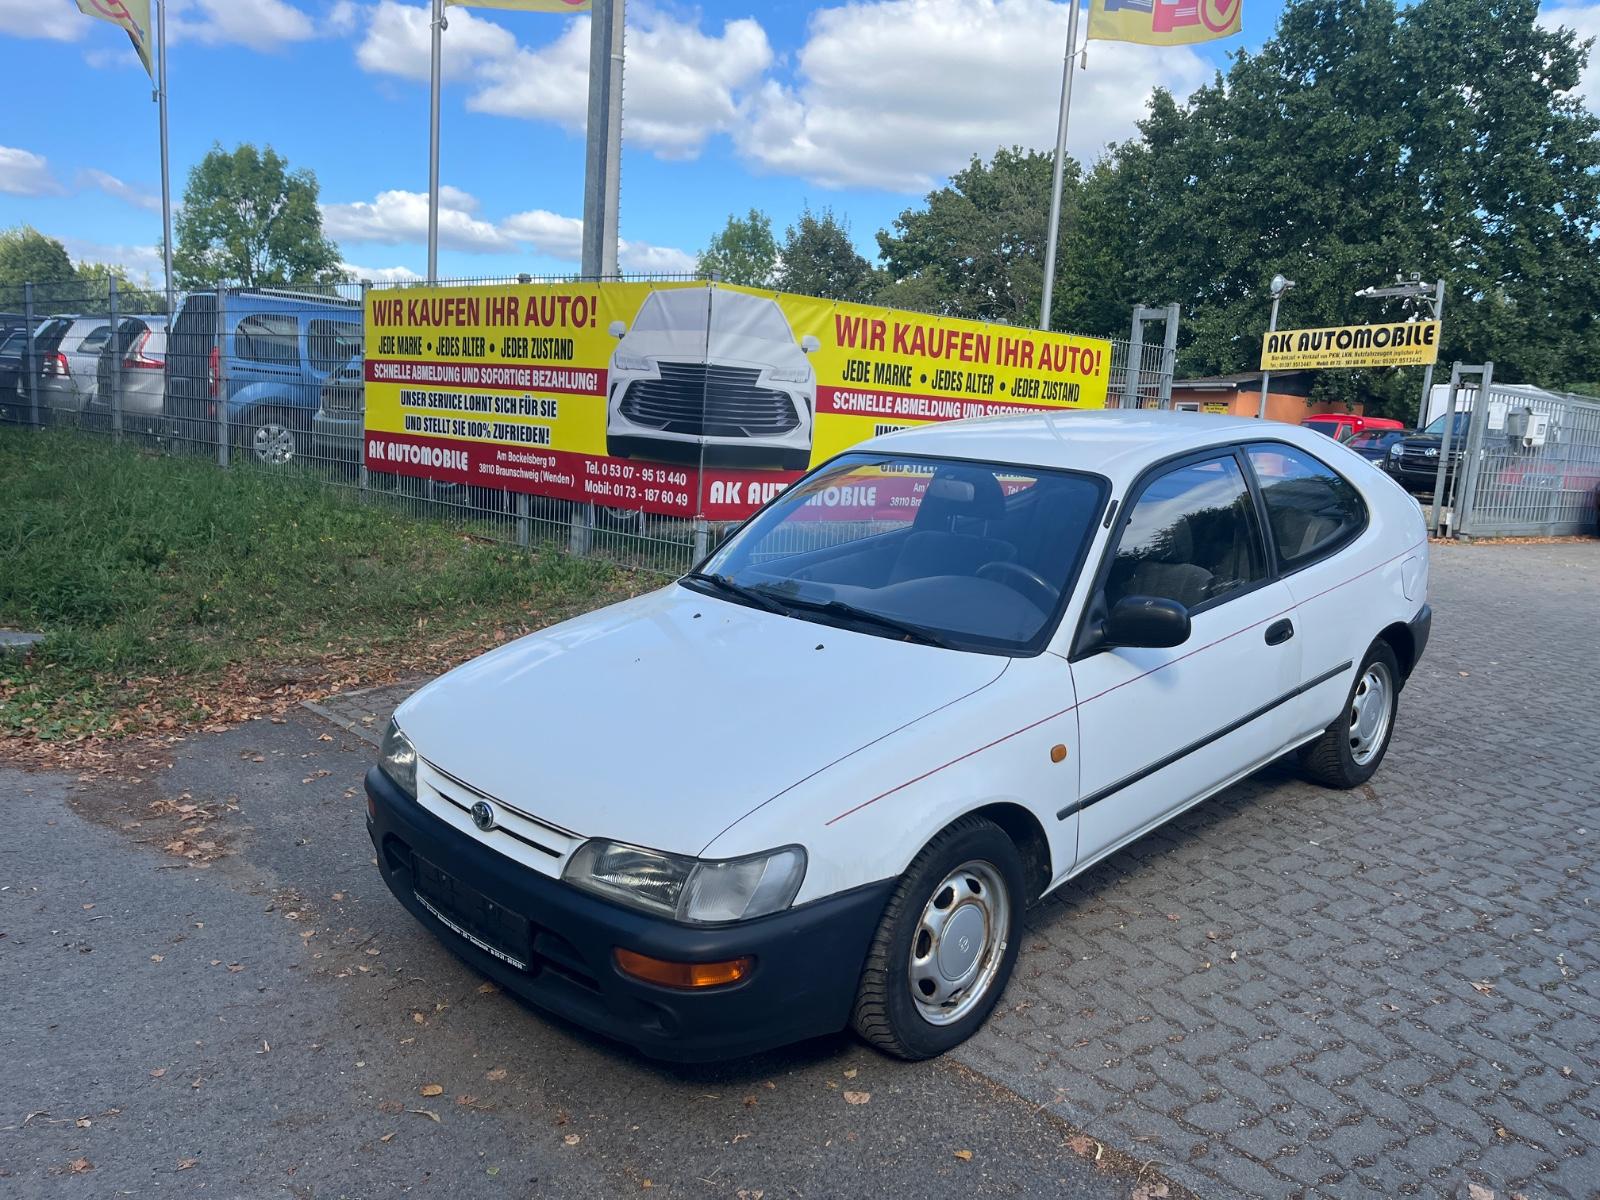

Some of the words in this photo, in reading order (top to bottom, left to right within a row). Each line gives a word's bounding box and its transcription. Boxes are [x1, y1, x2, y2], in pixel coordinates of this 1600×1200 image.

[373, 299, 404, 326] WIR
[408, 297, 480, 327] KAUFEN
[485, 296, 519, 327] IHR
[524, 295, 597, 328] AUTO!
[378, 336, 395, 354] JEDE
[397, 336, 422, 355] MARKE
[436, 336, 460, 356] JEDES
[462, 337, 485, 357] ALTER
[501, 337, 528, 358] JEDER
[531, 338, 574, 360] ZUSTAND
[835, 314, 885, 352] WIR
[892, 322, 991, 363] KAUFEN
[996, 337, 1034, 368] IHR
[1038, 343, 1101, 376] AUTO!
[1267, 333, 1294, 353] AK
[1297, 325, 1435, 351] AUTOMOBILE
[374, 364, 411, 380] SCHNELLE
[412, 365, 460, 382] ABMELDUNG
[461, 367, 479, 383] UND
[481, 369, 531, 386] SOFORTIGE
[532, 371, 598, 391] BEZAHLUNG!
[842, 359, 871, 383] JEDE
[873, 363, 912, 387] MARKE
[931, 369, 963, 392] JEDES
[965, 372, 994, 395] ALTER
[1010, 377, 1039, 399] JEDER
[1041, 380, 1080, 402] ZUSTAND
[401, 390, 427, 407] UNSER
[428, 392, 462, 410] SERVICE
[464, 395, 493, 412] LOHNT
[494, 397, 518, 414] SICH
[519, 395, 538, 415] FÜR
[540, 400, 557, 418] SIE
[832, 391, 893, 412] SCHNELLE
[894, 396, 961, 418] ABMELDUNG
[963, 403, 984, 419] UND
[405, 415, 422, 431] UND
[423, 418, 451, 434] STELLT
[452, 421, 466, 436] SIE
[467, 422, 491, 438] 100%
[493, 425, 550, 444] ZUFRIEDEN!
[369, 440, 385, 459] AK
[388, 443, 468, 471] AUTOMOBILE
[496, 450, 507, 461] Am
[508, 451, 547, 468] Bockelsberg
[548, 456, 556, 467] 10
[478, 463, 495, 474] 38110
[495, 465, 539, 483] Braunschweig
[584, 460, 600, 475] Tel.
[602, 463, 608, 475] 0
[610, 464, 621, 478] 53
[623, 466, 634, 479] 07
[642, 468, 654, 482] 95
[656, 470, 666, 483] 13
[668, 472, 687, 486] 440
[584, 479, 611, 495] Mobil:
[613, 483, 623, 497] 01
[625, 485, 637, 499] 73
[644, 489, 660, 501] 187
[661, 491, 674, 504] 60
[675, 493, 688, 507] 49
[709, 481, 743, 504] AK
[889, 496, 909, 507] 38110
[913, 482, 925, 493] Am
